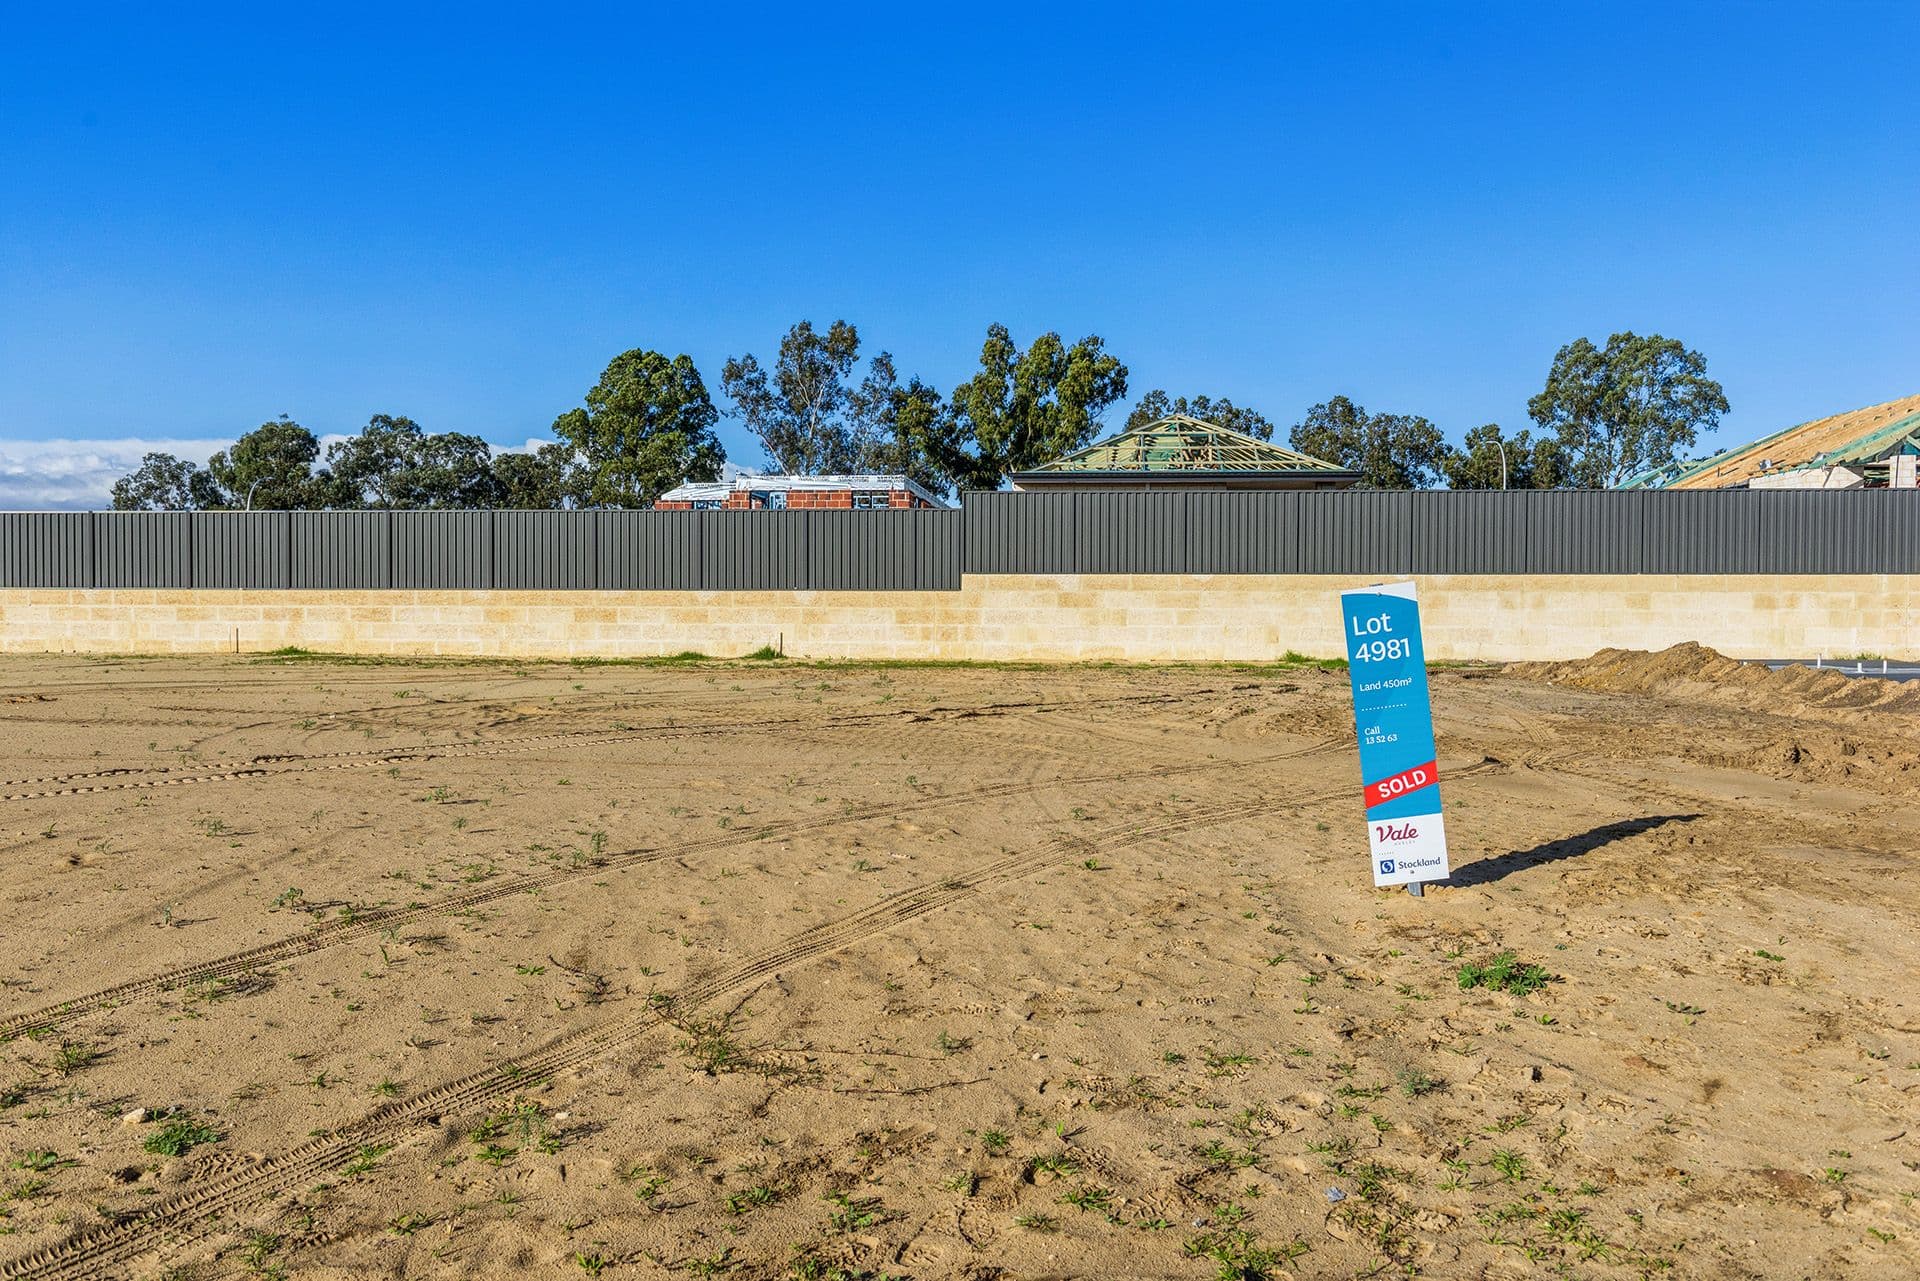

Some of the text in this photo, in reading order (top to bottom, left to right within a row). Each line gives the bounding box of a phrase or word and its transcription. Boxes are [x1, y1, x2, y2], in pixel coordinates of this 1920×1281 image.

[1353, 613, 1392, 636] Lot
[1355, 637, 1411, 662] 4981
[1359, 680, 1381, 692] Land
[1364, 726, 1380, 736] Call
[1366, 733, 1398, 745] 13 52 63
[1378, 770, 1427, 798] SOLD
[1376, 823, 1419, 843] Vale
[1398, 857, 1441, 870] Stockland
